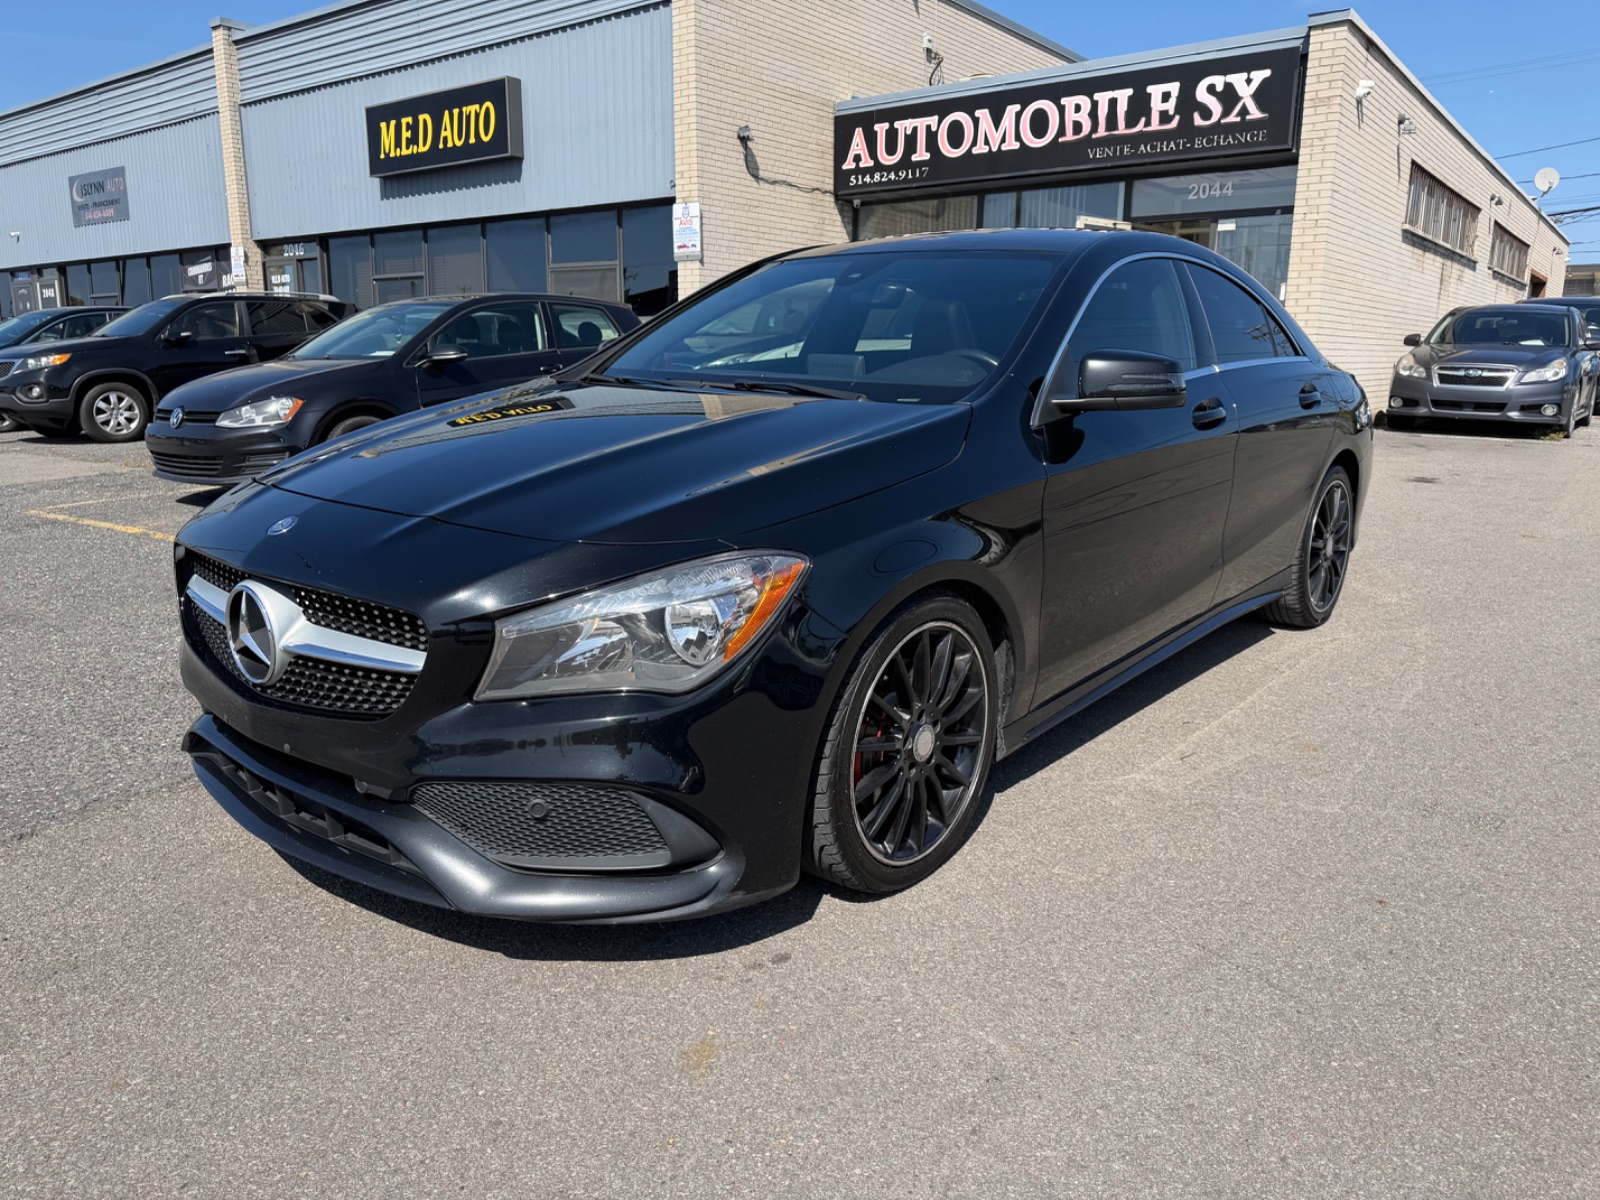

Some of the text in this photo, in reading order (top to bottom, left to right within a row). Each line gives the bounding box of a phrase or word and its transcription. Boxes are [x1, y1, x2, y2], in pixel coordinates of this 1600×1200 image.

[841, 68, 1272, 170] AUTOMOBILE SX
[379, 100, 496, 160] M.E.D AUTO
[1194, 129, 1267, 149] ECHANGE
[848, 166, 930, 187] 514.824.9117
[1187, 180, 1234, 200] 2044
